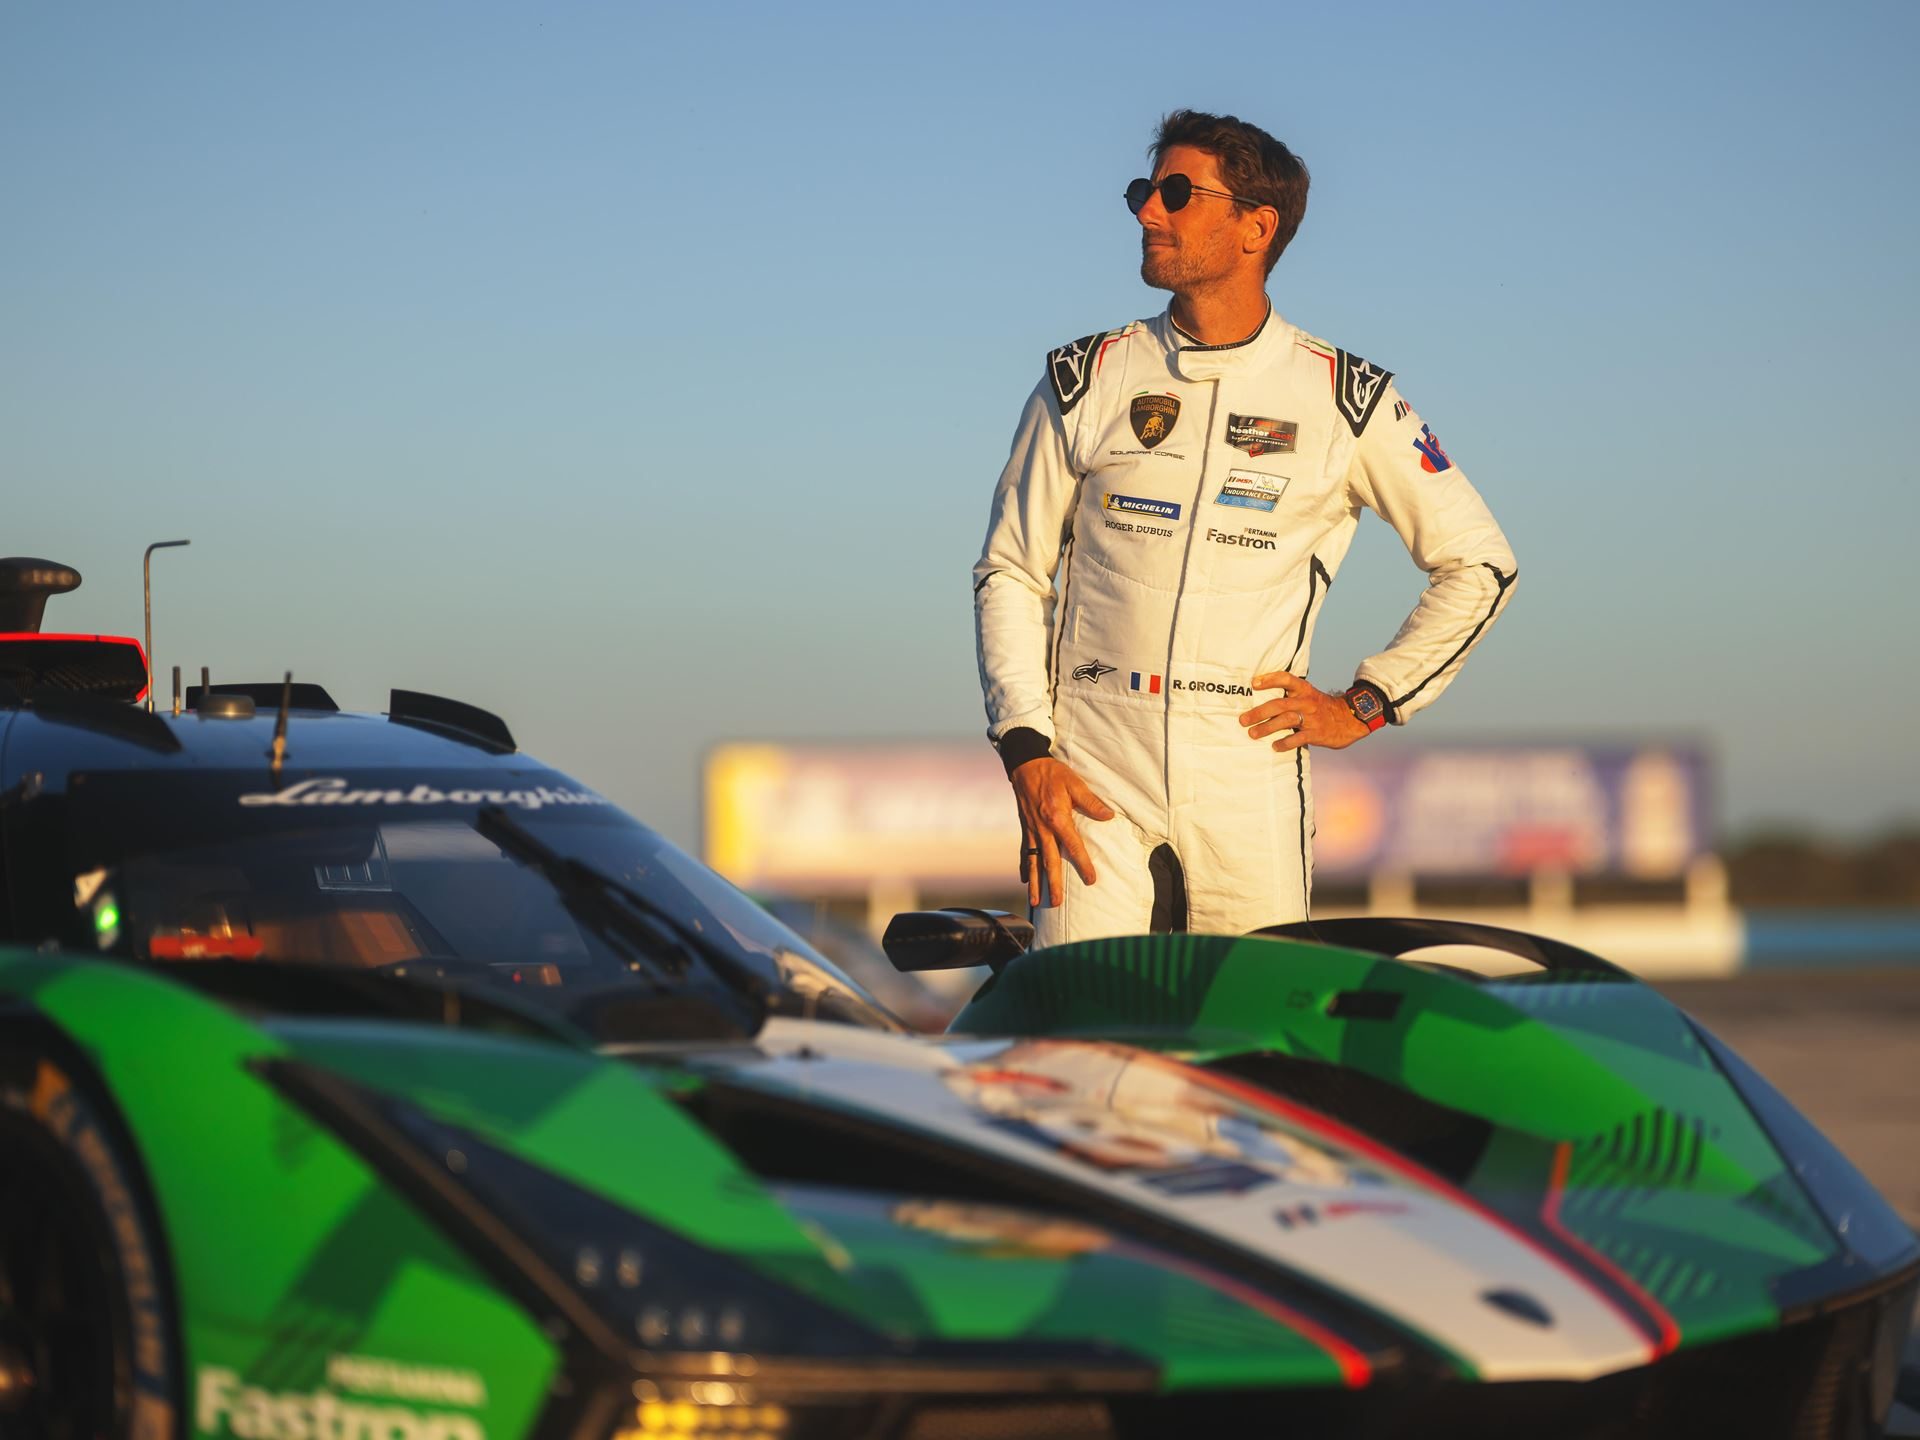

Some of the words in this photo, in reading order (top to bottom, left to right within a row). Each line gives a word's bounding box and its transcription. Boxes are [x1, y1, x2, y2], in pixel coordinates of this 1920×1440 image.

[1154, 451, 1186, 460] CORSE
[1122, 501, 1174, 514] MICHELIN
[1105, 520, 1134, 532] ROGER
[1136, 525, 1173, 537] DUBUIS
[1244, 527, 1277, 538] PERTAMINA
[1206, 528, 1276, 550] Fastron
[1173, 680, 1186, 690] R.
[1188, 681, 1253, 696] GROSJEAN
